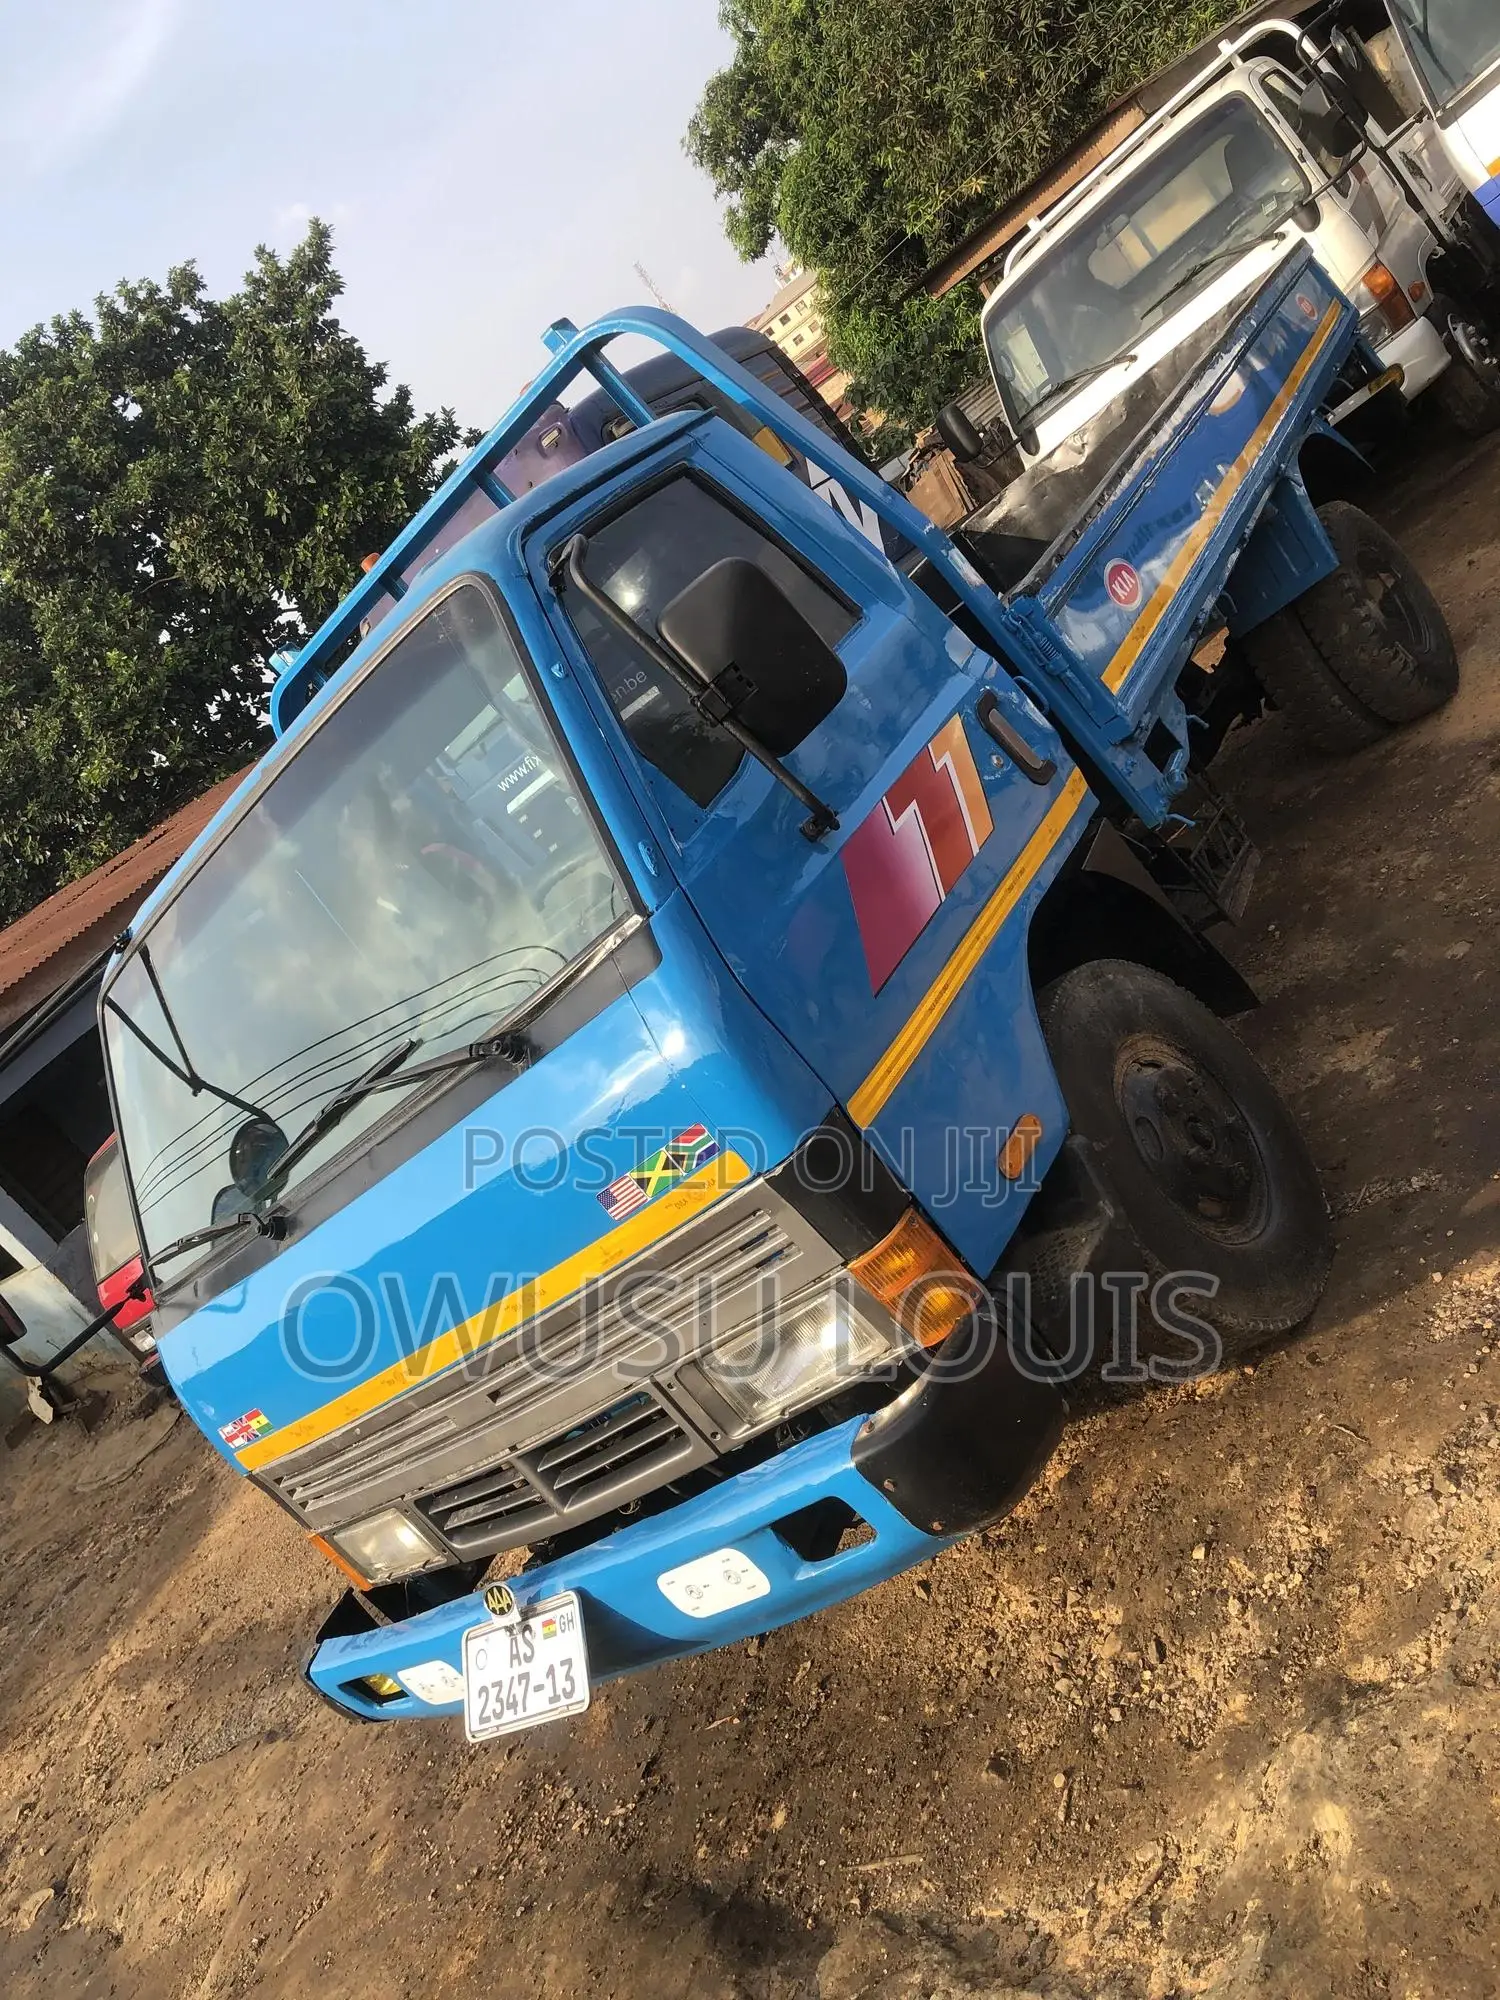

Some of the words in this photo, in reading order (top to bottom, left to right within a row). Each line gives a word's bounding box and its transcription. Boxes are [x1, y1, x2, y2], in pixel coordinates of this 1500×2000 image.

[1112, 570, 1135, 600] KIA
[510, 1624, 535, 1668] AS
[559, 1611, 574, 1633] GH
[478, 1658, 575, 1725] 2347-13
